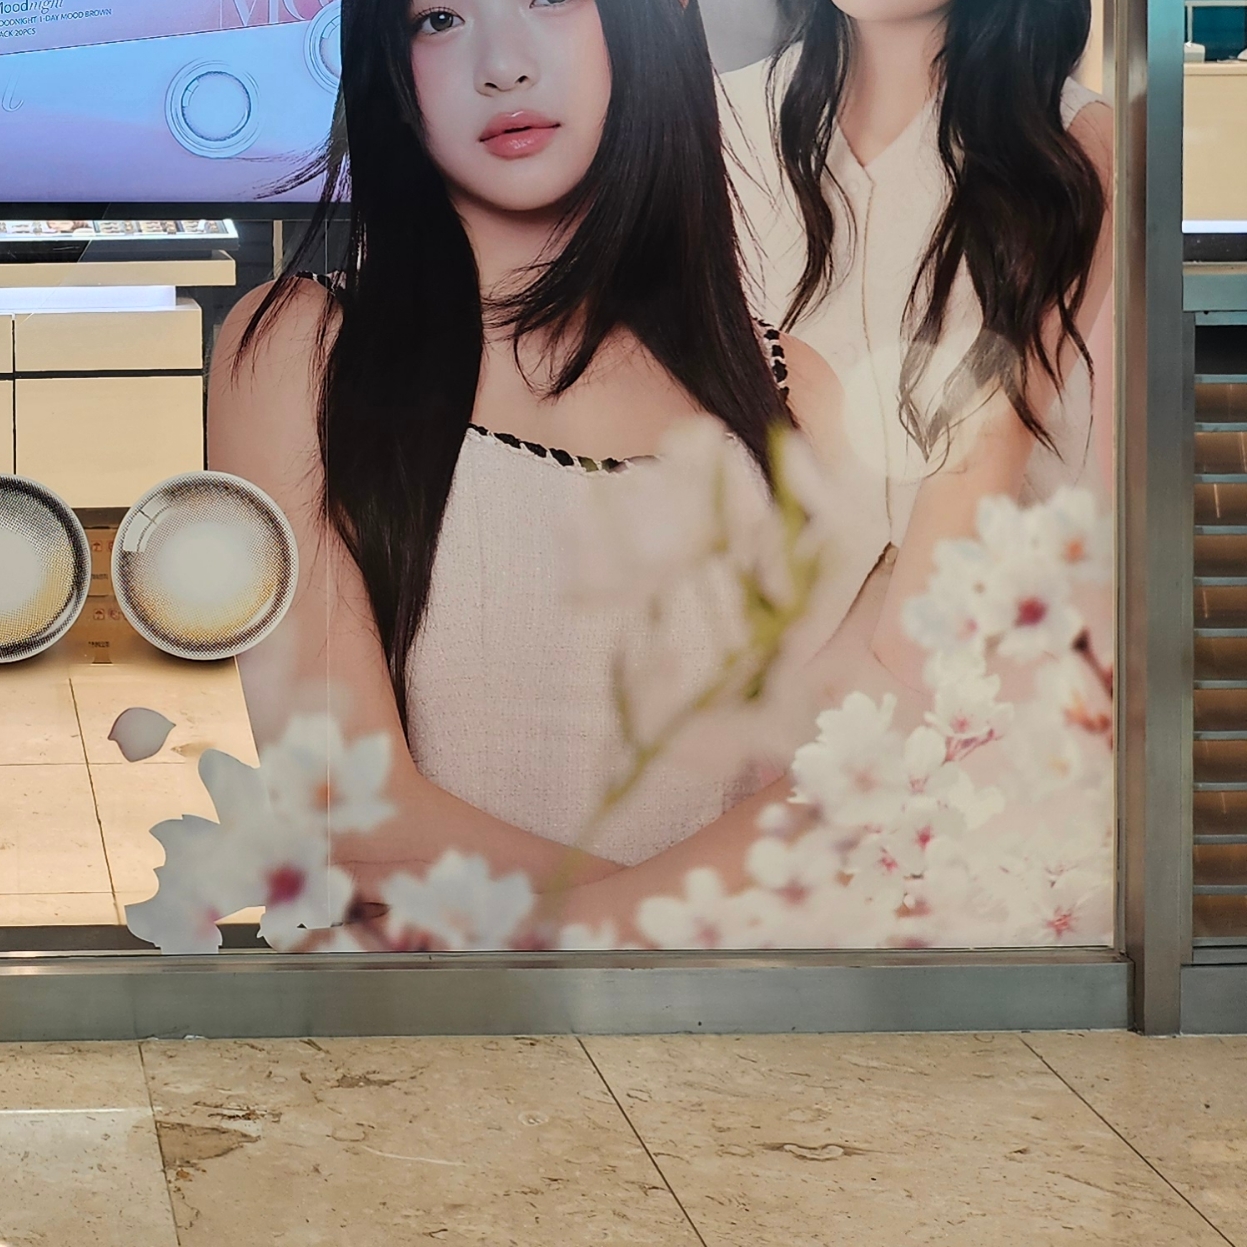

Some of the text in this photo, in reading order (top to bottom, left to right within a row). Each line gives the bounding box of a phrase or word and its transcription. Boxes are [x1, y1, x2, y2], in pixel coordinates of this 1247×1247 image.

[39, 14, 59, 23] 1-DAY
[60, 11, 84, 21] MOOD
[85, 8, 112, 18] BROWN
[14, 27, 36, 38] 20PCS
